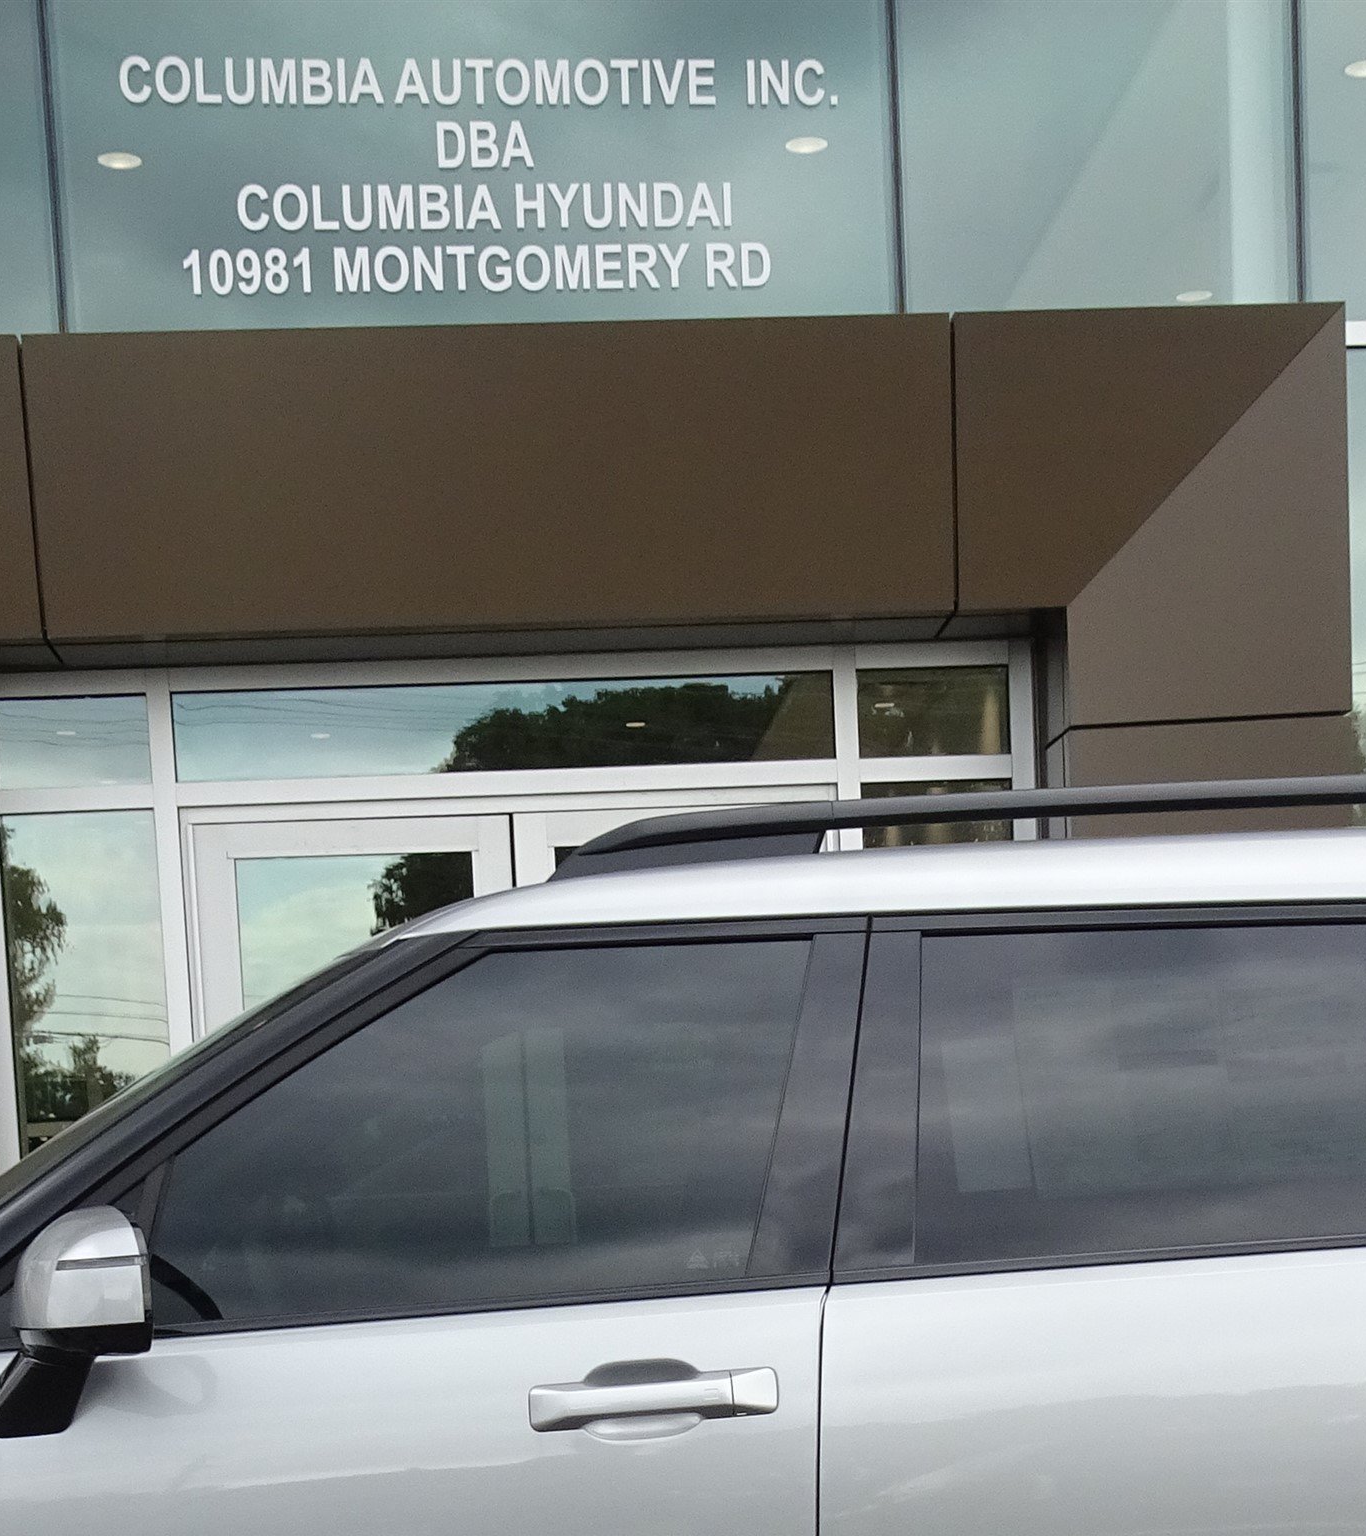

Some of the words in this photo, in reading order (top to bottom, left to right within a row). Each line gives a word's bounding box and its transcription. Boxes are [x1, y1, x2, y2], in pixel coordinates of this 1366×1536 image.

[119, 55, 385, 105] COLUMBIA
[394, 57, 717, 106] AUTOMOTIVE
[746, 59, 839, 106] INC.
[435, 120, 535, 168] DBA
[237, 183, 502, 231] COLUMBIA
[514, 180, 733, 229] HYUNDAI
[183, 247, 312, 295] 10981
[333, 242, 691, 292] MONTGOMERY
[704, 240, 772, 288] RD
